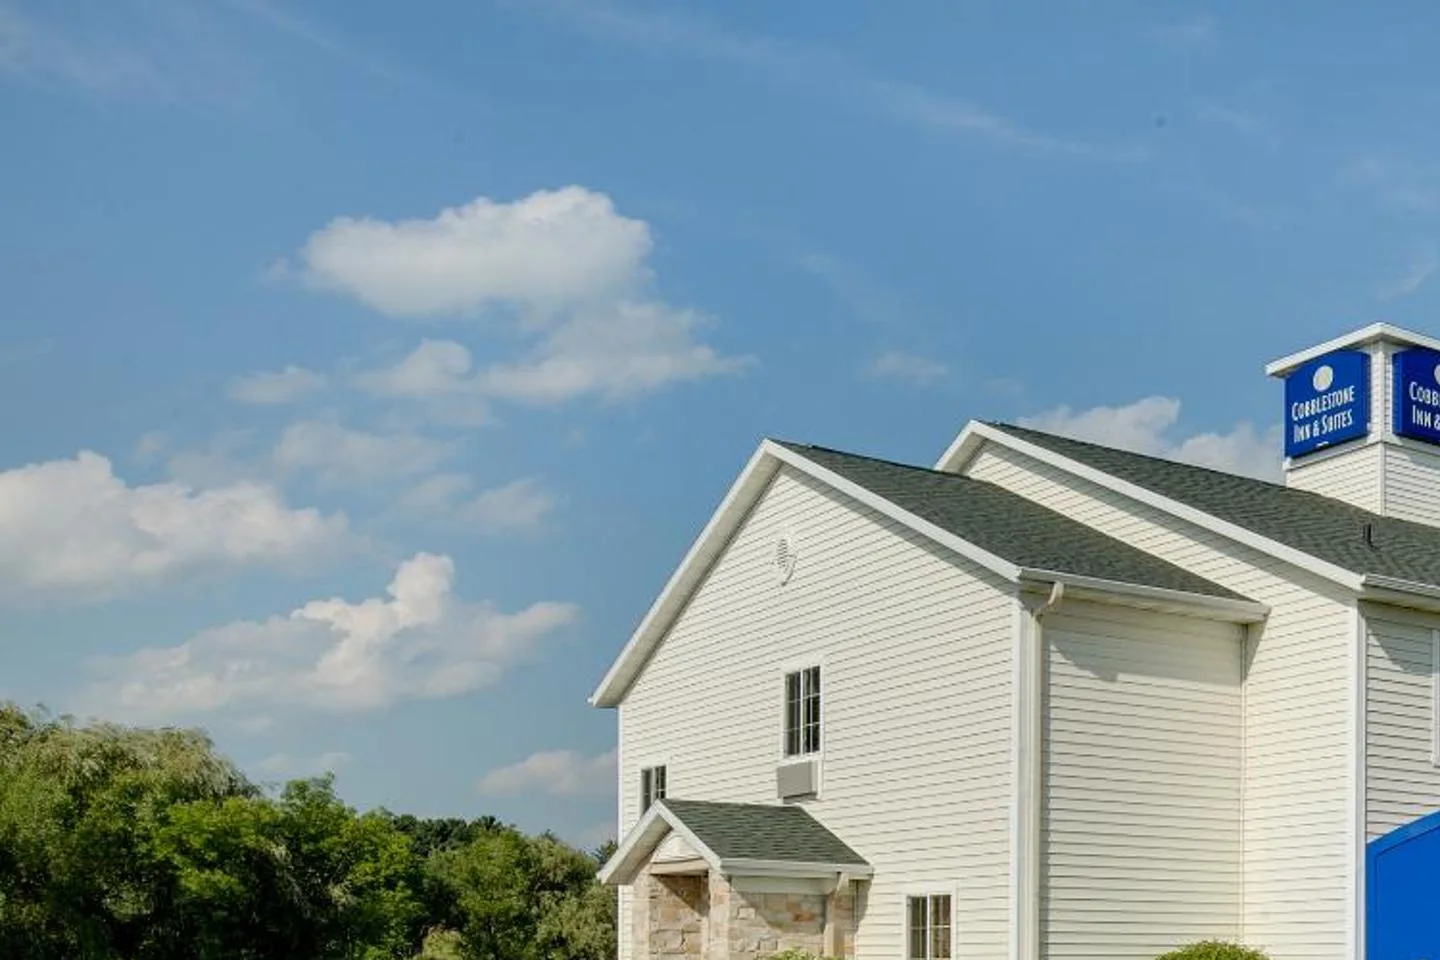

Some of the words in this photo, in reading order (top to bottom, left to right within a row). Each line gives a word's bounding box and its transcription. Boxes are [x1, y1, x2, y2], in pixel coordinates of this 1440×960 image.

[1291, 385, 1355, 422] COBBLESTONE
[1411, 404, 1432, 429] INN
[1293, 423, 1311, 443] INN
[1312, 419, 1320, 437] &
[1321, 408, 1353, 434] SUITES
